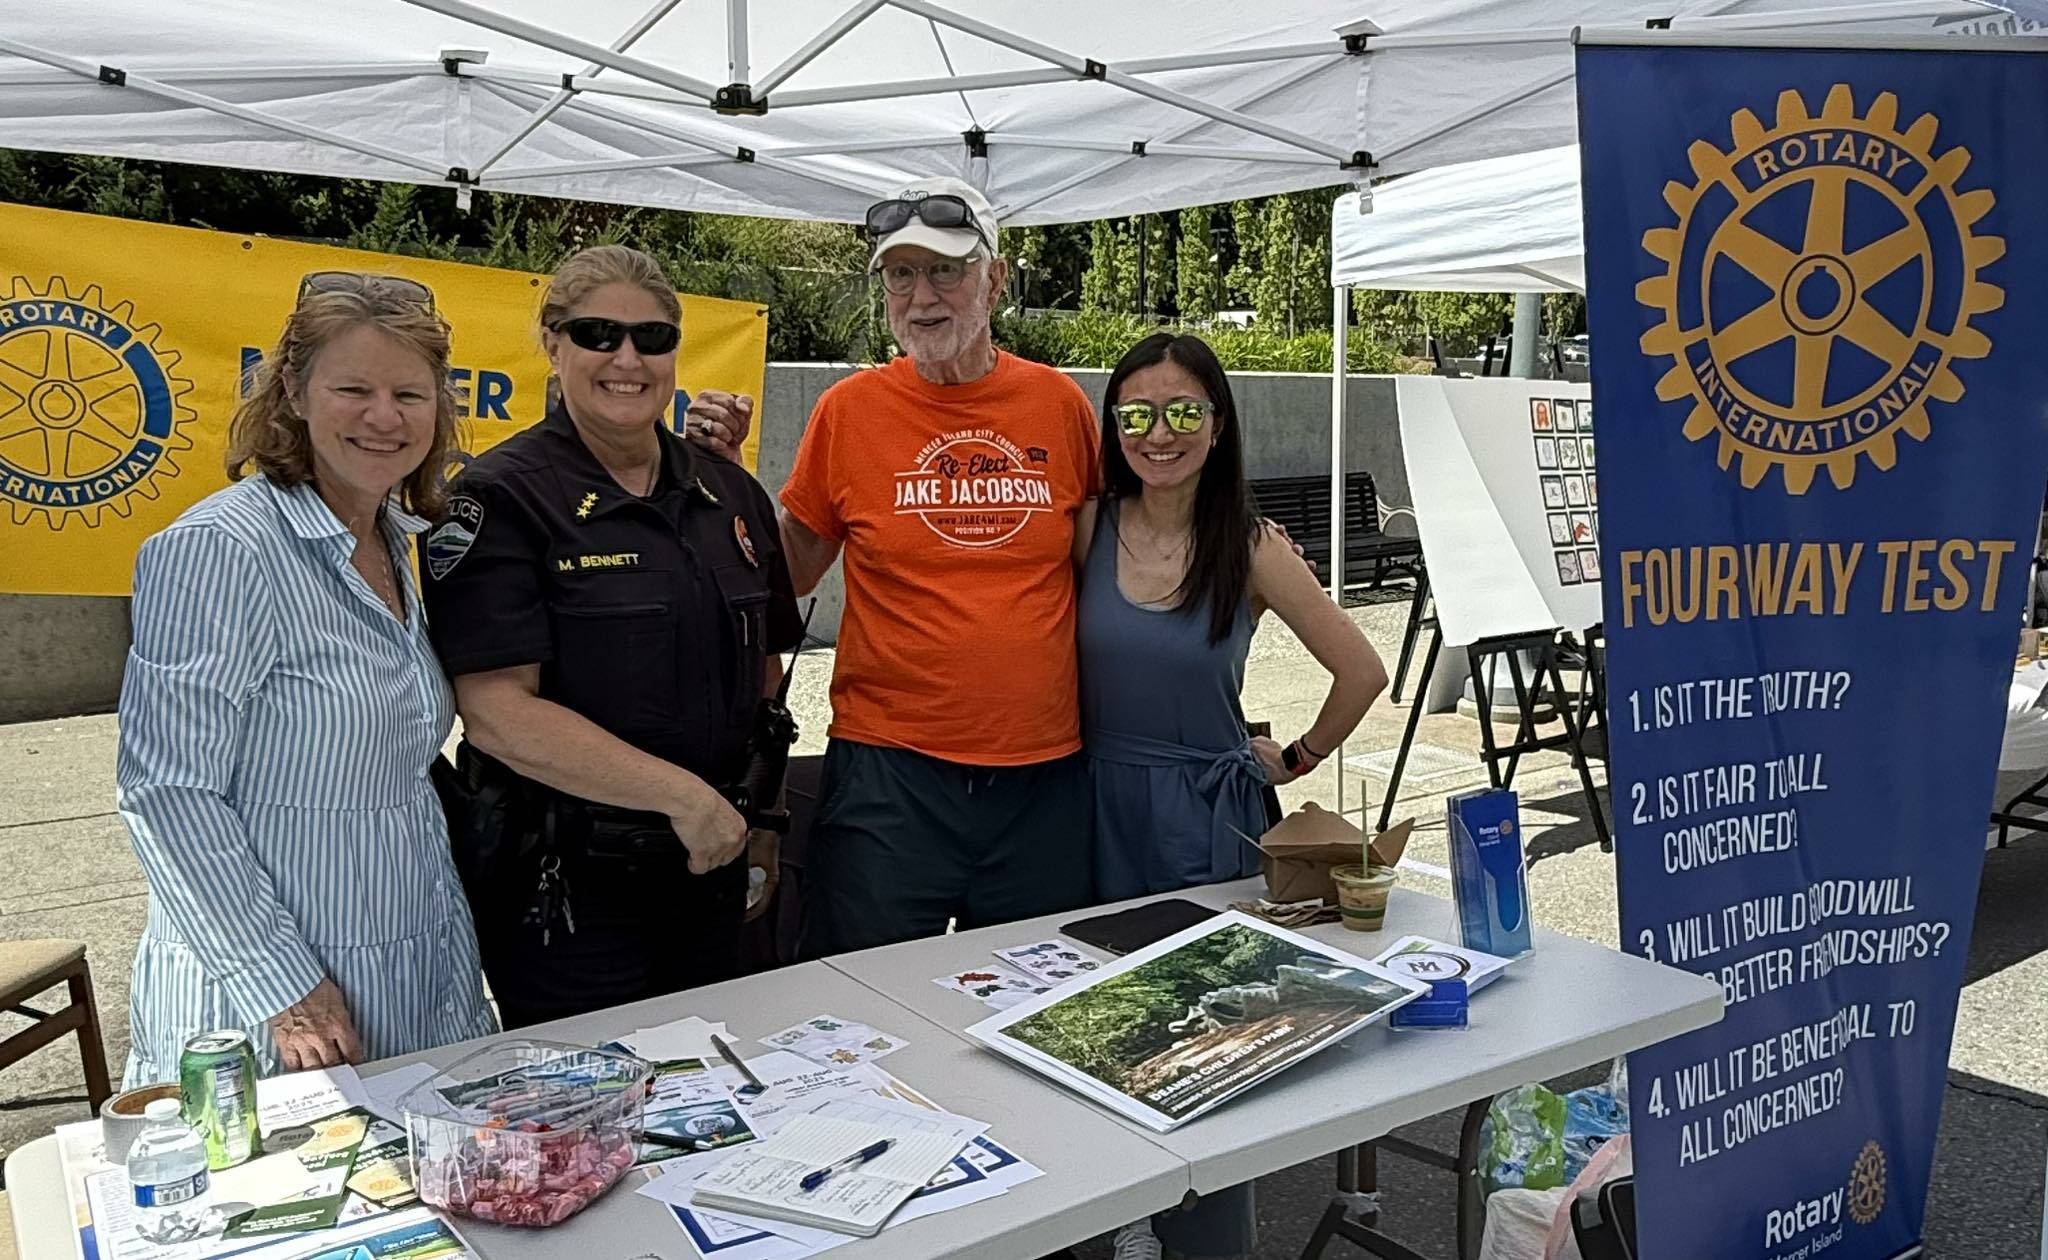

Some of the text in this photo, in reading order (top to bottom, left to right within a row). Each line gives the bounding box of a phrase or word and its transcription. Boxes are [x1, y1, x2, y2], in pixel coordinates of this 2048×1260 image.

[1752, 132, 1912, 180] ROTARY
[1, 303, 117, 337] ROTARY
[1694, 357, 1936, 451] INTERNATIONAL
[913, 436, 943, 465] MERCER
[942, 429, 973, 442] ISLAND
[975, 428, 995, 439] CITY
[995, 434, 1026, 462] COUNCIL
[935, 453, 1010, 479] Re-Elect
[893, 477, 1053, 507] JAKE JACOBSON
[558, 553, 639, 571] M. BENNETT
[1620, 539, 2016, 628] FOUR WAY TEST
[1629, 671, 1851, 732] 1. IS IT THE TRUTH?
[1631, 753, 1828, 826] 2. IS IT FAIR TO ALL
[1663, 808, 1799, 874] CONCERNED?
[1667, 913, 1721, 964] WILL
[1723, 905, 1739, 947] IT
[1742, 892, 1807, 942] BUILD
[1809, 876, 1915, 926] GOODWILL
[1722, 948, 1793, 1007] BETTER
[1149, 1072, 1202, 1102] DEANE'S
[1199, 1038, 1266, 1076] CHILDREN'S
[1262, 1023, 1295, 1045] PARK
[1648, 1077, 1671, 1119] 4.
[1675, 1057, 1726, 1111] WILL
[1729, 1048, 1747, 1091] IT
[1752, 1038, 1778, 1083] BE
[1888, 1000, 1916, 1038] TO
[1680, 1067, 1844, 1168] ALL CONCERNED?
[1765, 1187, 1844, 1249] Rotary
[1812, 1223, 1844, 1254] Island
